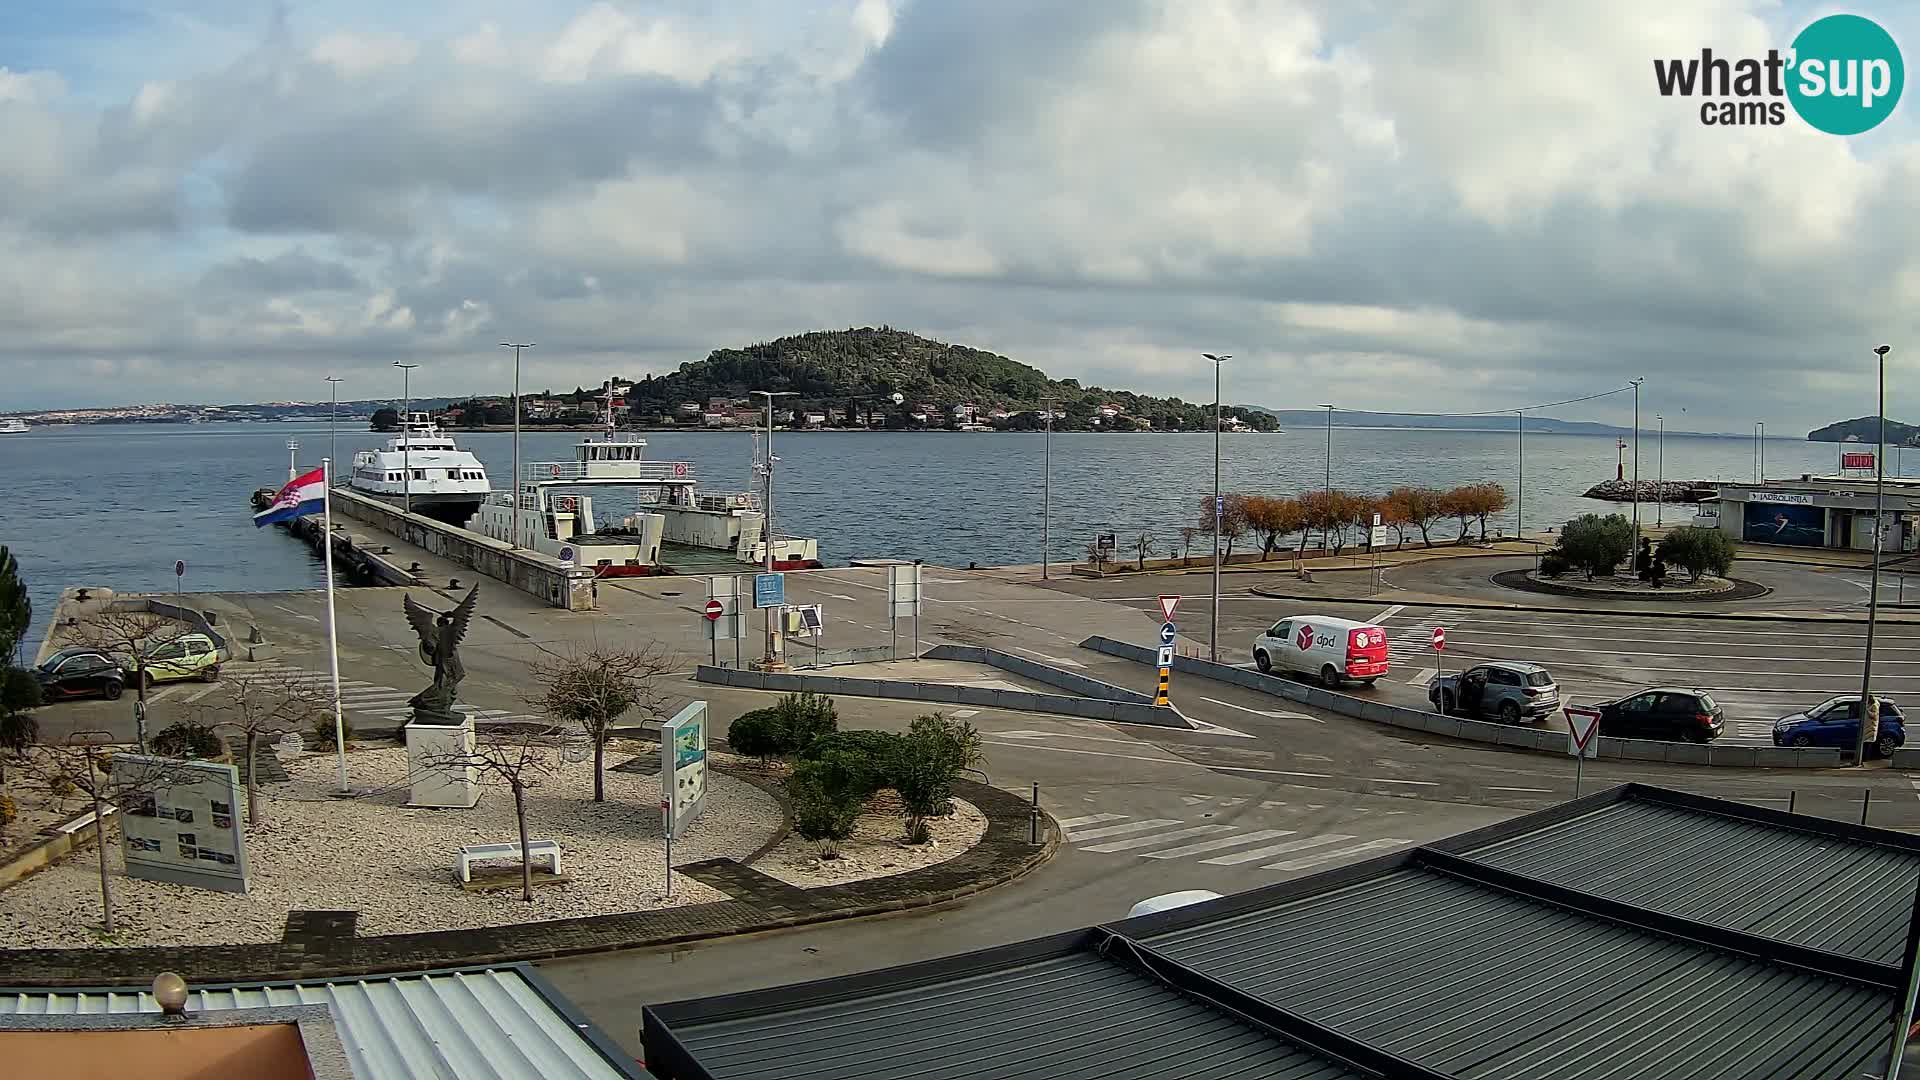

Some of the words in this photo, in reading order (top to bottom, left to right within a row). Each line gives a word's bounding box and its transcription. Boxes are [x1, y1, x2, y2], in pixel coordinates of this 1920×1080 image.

[1759, 494, 1808, 503] JADROLINIJA
[1316, 633, 1337, 648] dpd
[1369, 633, 1382, 645] dpd
